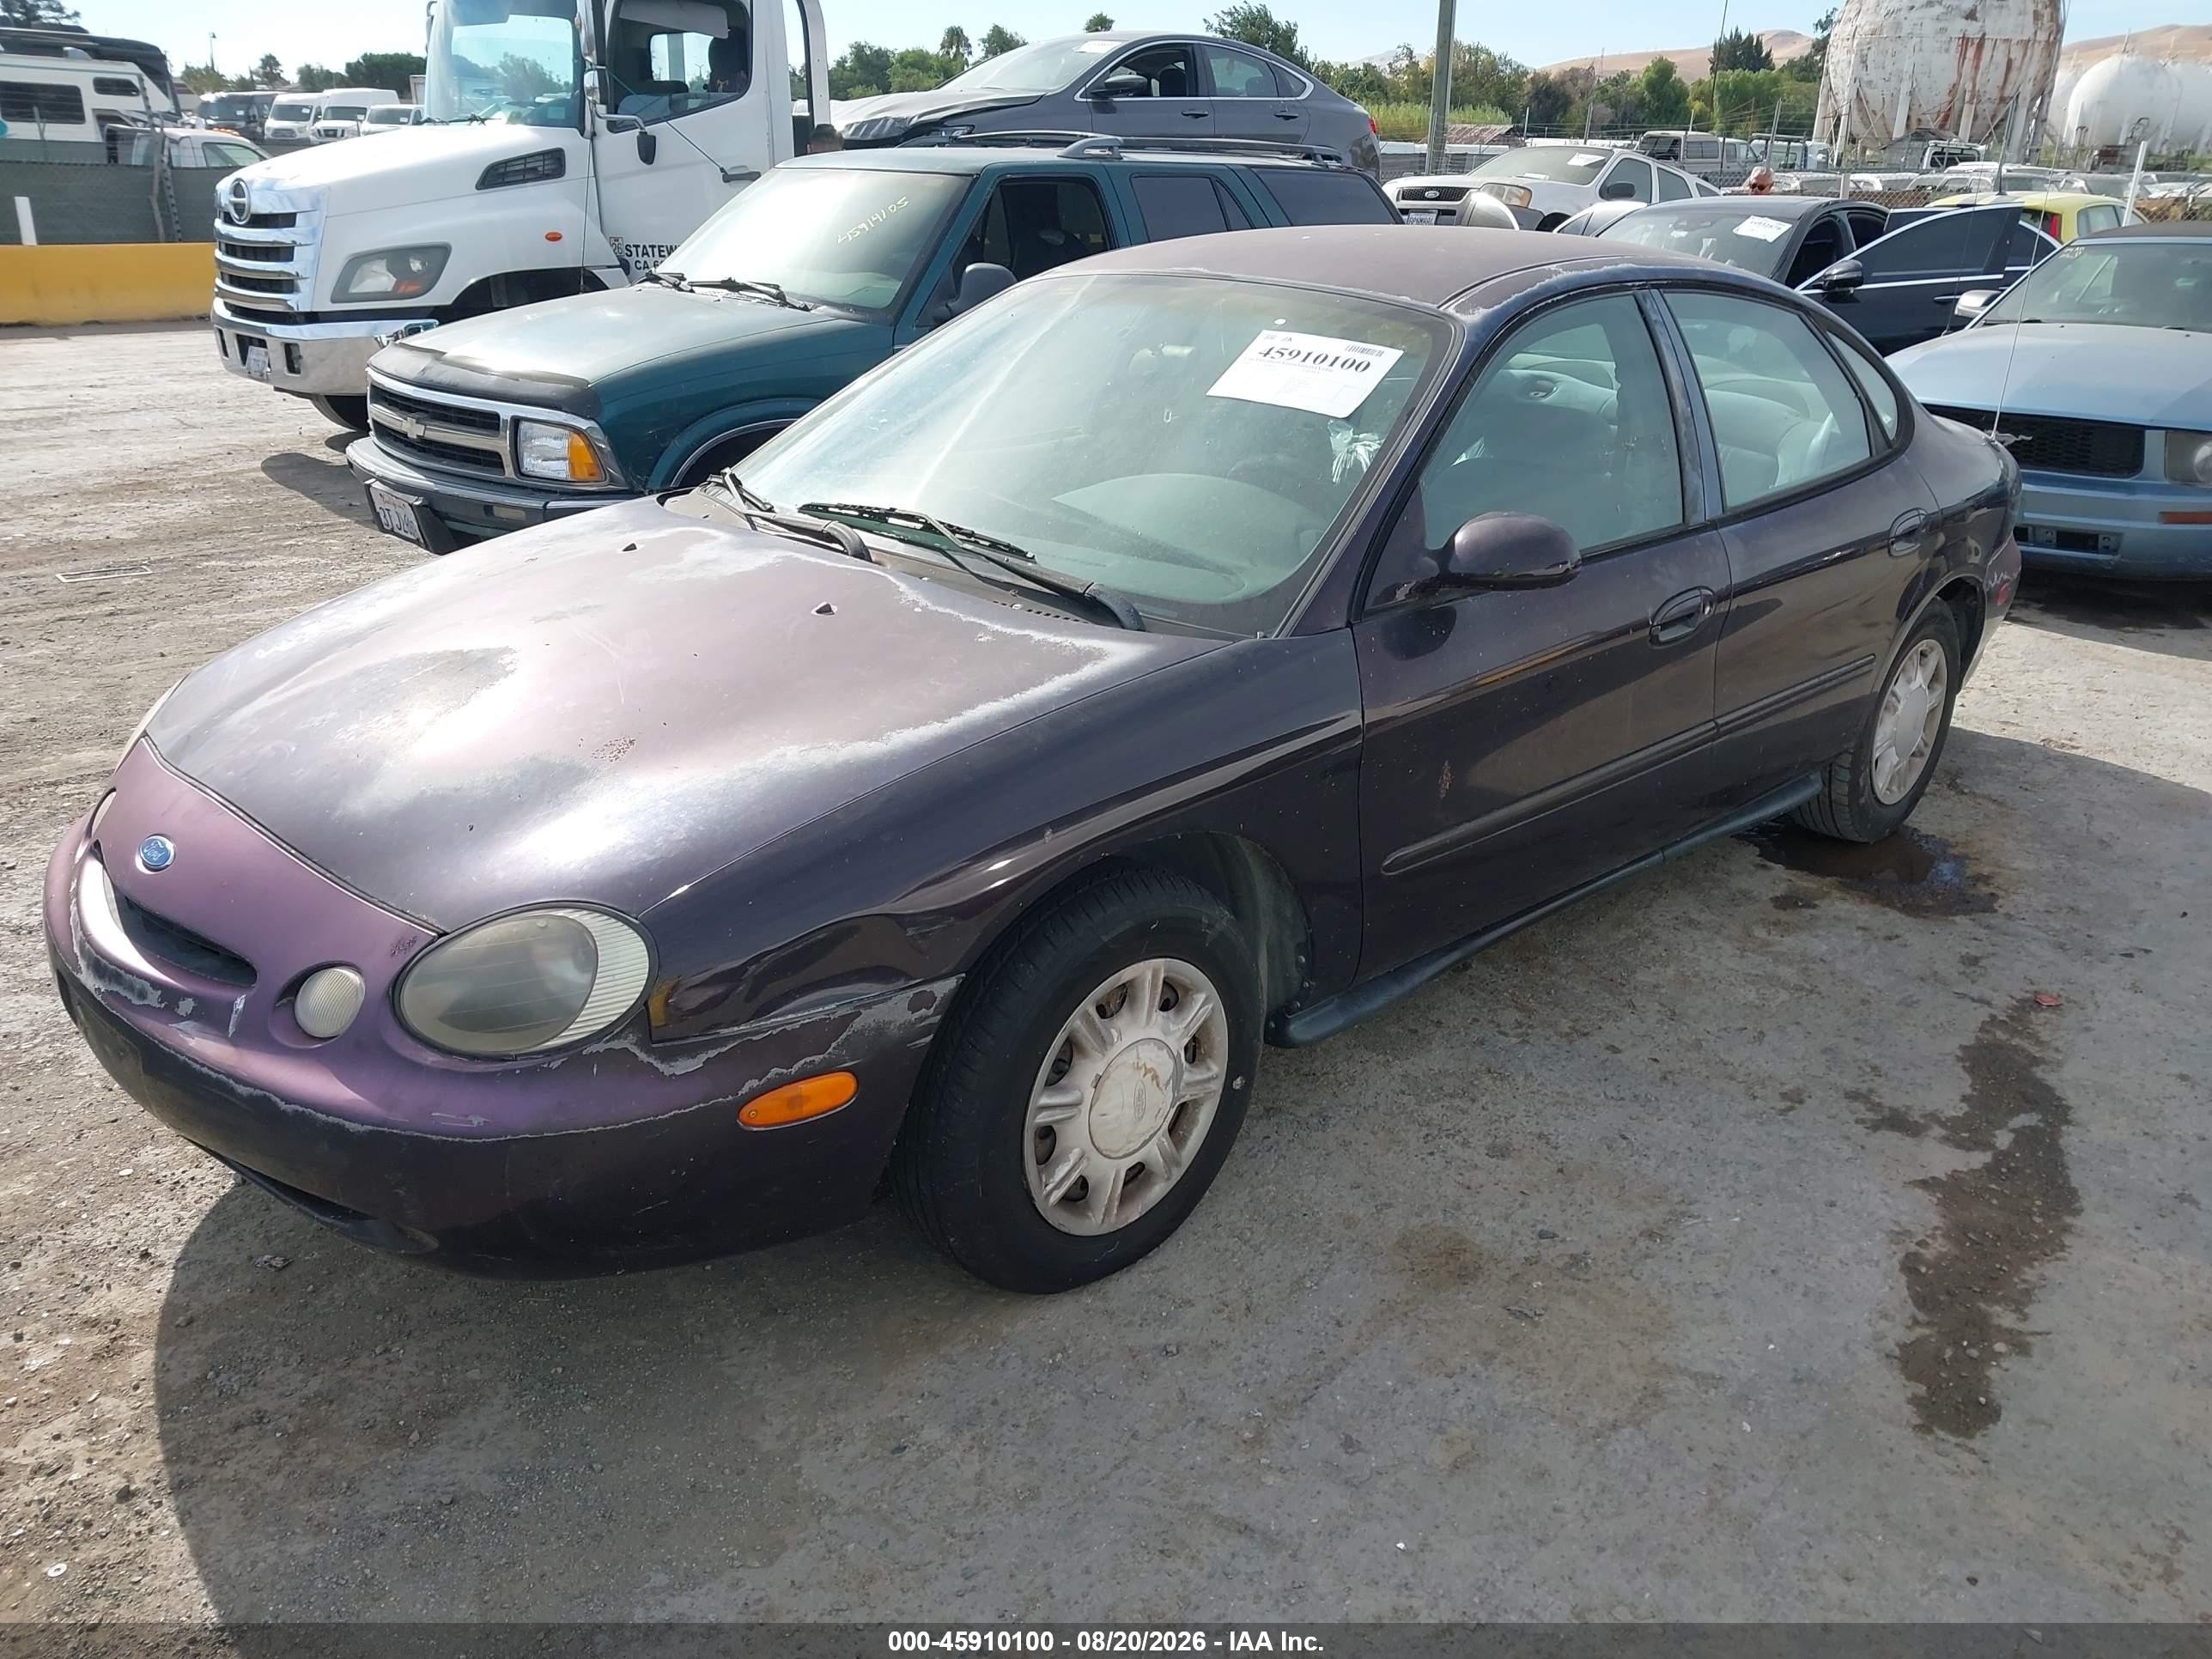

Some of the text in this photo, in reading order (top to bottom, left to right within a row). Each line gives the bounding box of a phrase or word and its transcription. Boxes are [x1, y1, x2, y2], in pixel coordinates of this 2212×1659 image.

[611, 242, 623, 254] 26
[635, 260, 650, 270] CA
[1258, 345, 1371, 373] 45910100
[143, 839, 166, 861] Ford
